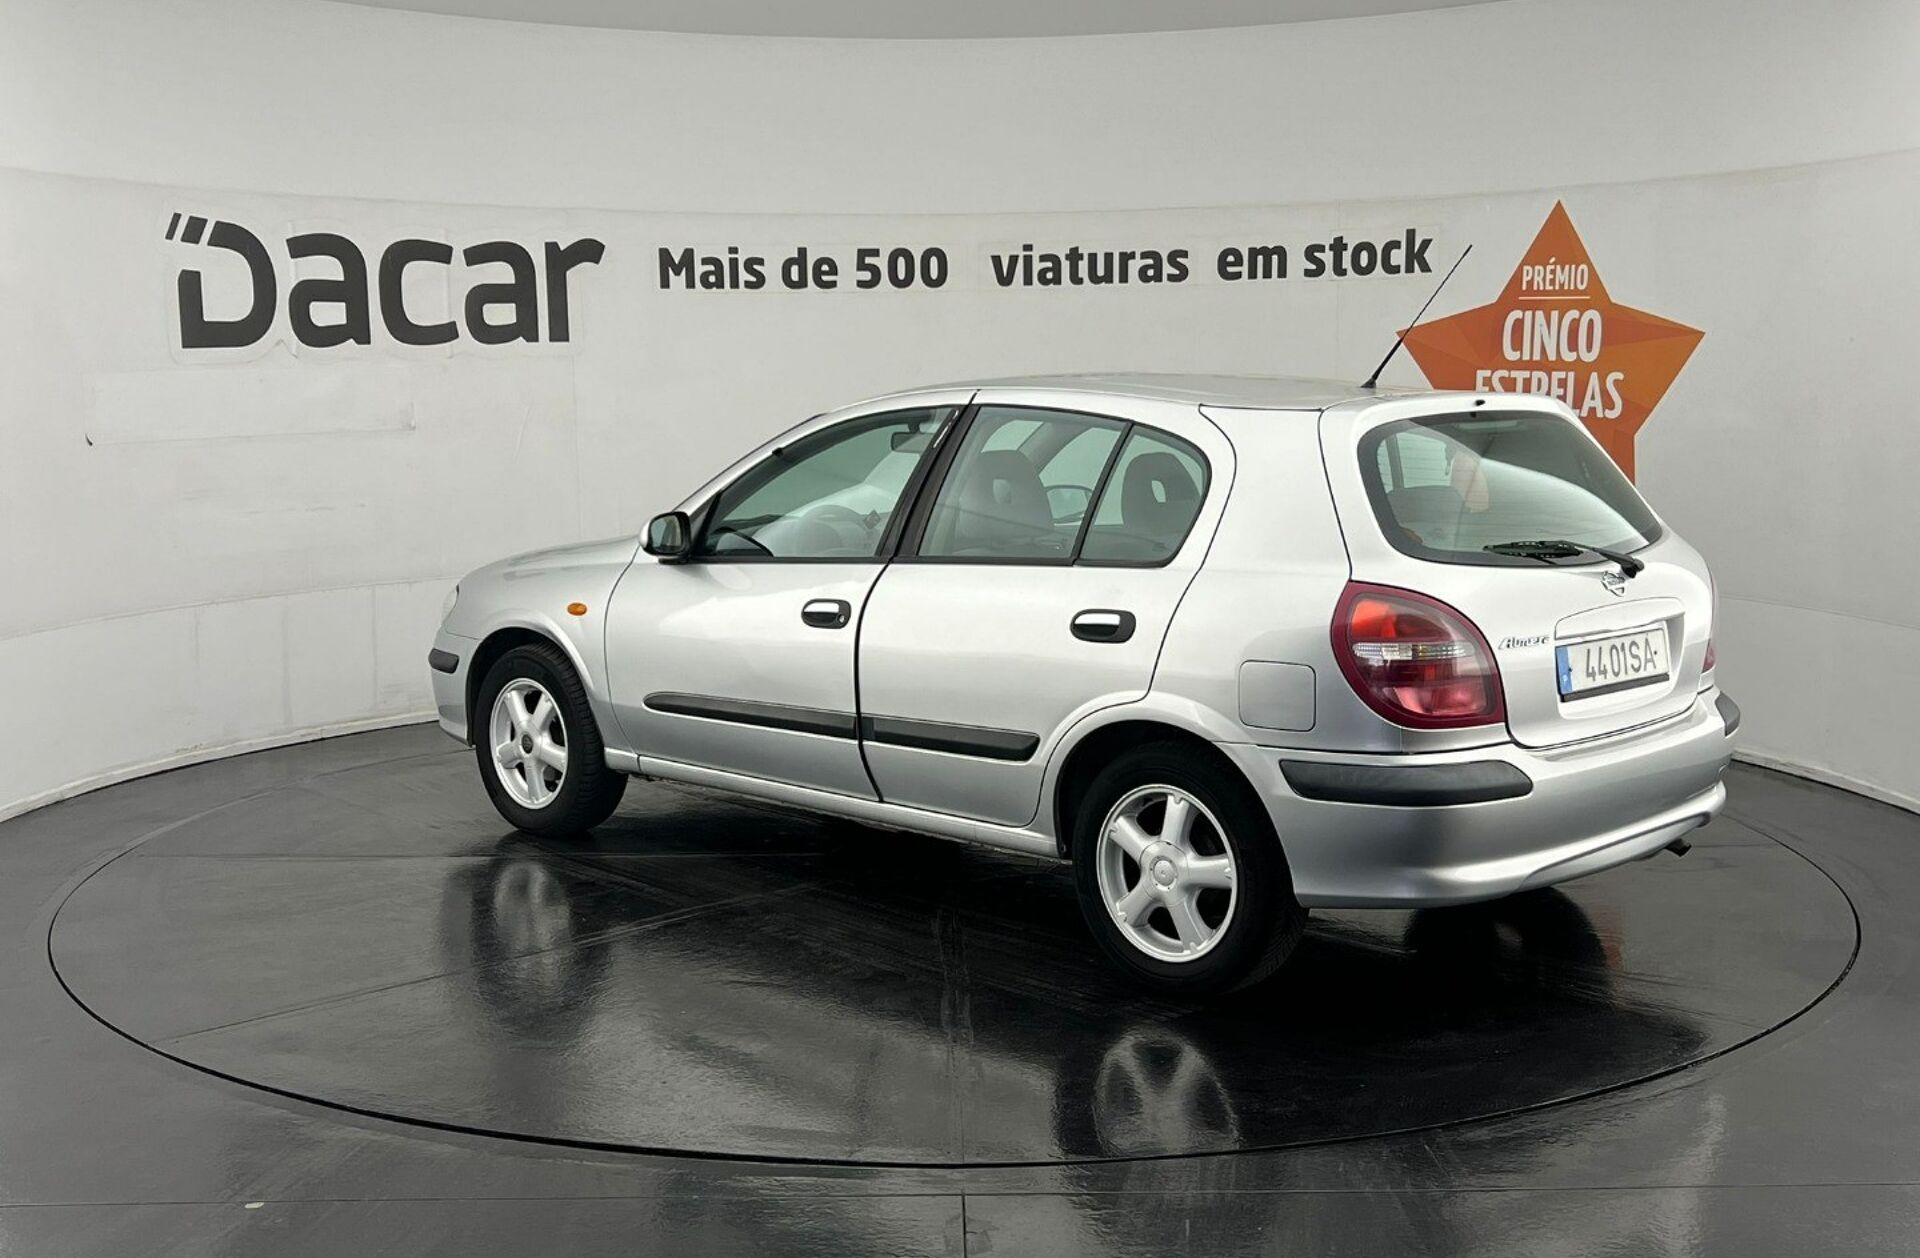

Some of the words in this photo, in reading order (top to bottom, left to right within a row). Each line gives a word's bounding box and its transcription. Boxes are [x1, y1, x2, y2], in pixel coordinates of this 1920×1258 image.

[165, 212, 605, 348] Dacar
[658, 246, 766, 290] Mais
[781, 247, 838, 289] de
[856, 247, 948, 289] 500
[991, 244, 1189, 287] viaturas
[1217, 244, 1288, 280] em
[1303, 228, 1433, 278] stock
[1521, 257, 1589, 291] PRÉMIO
[1502, 309, 1603, 362] CINCO
